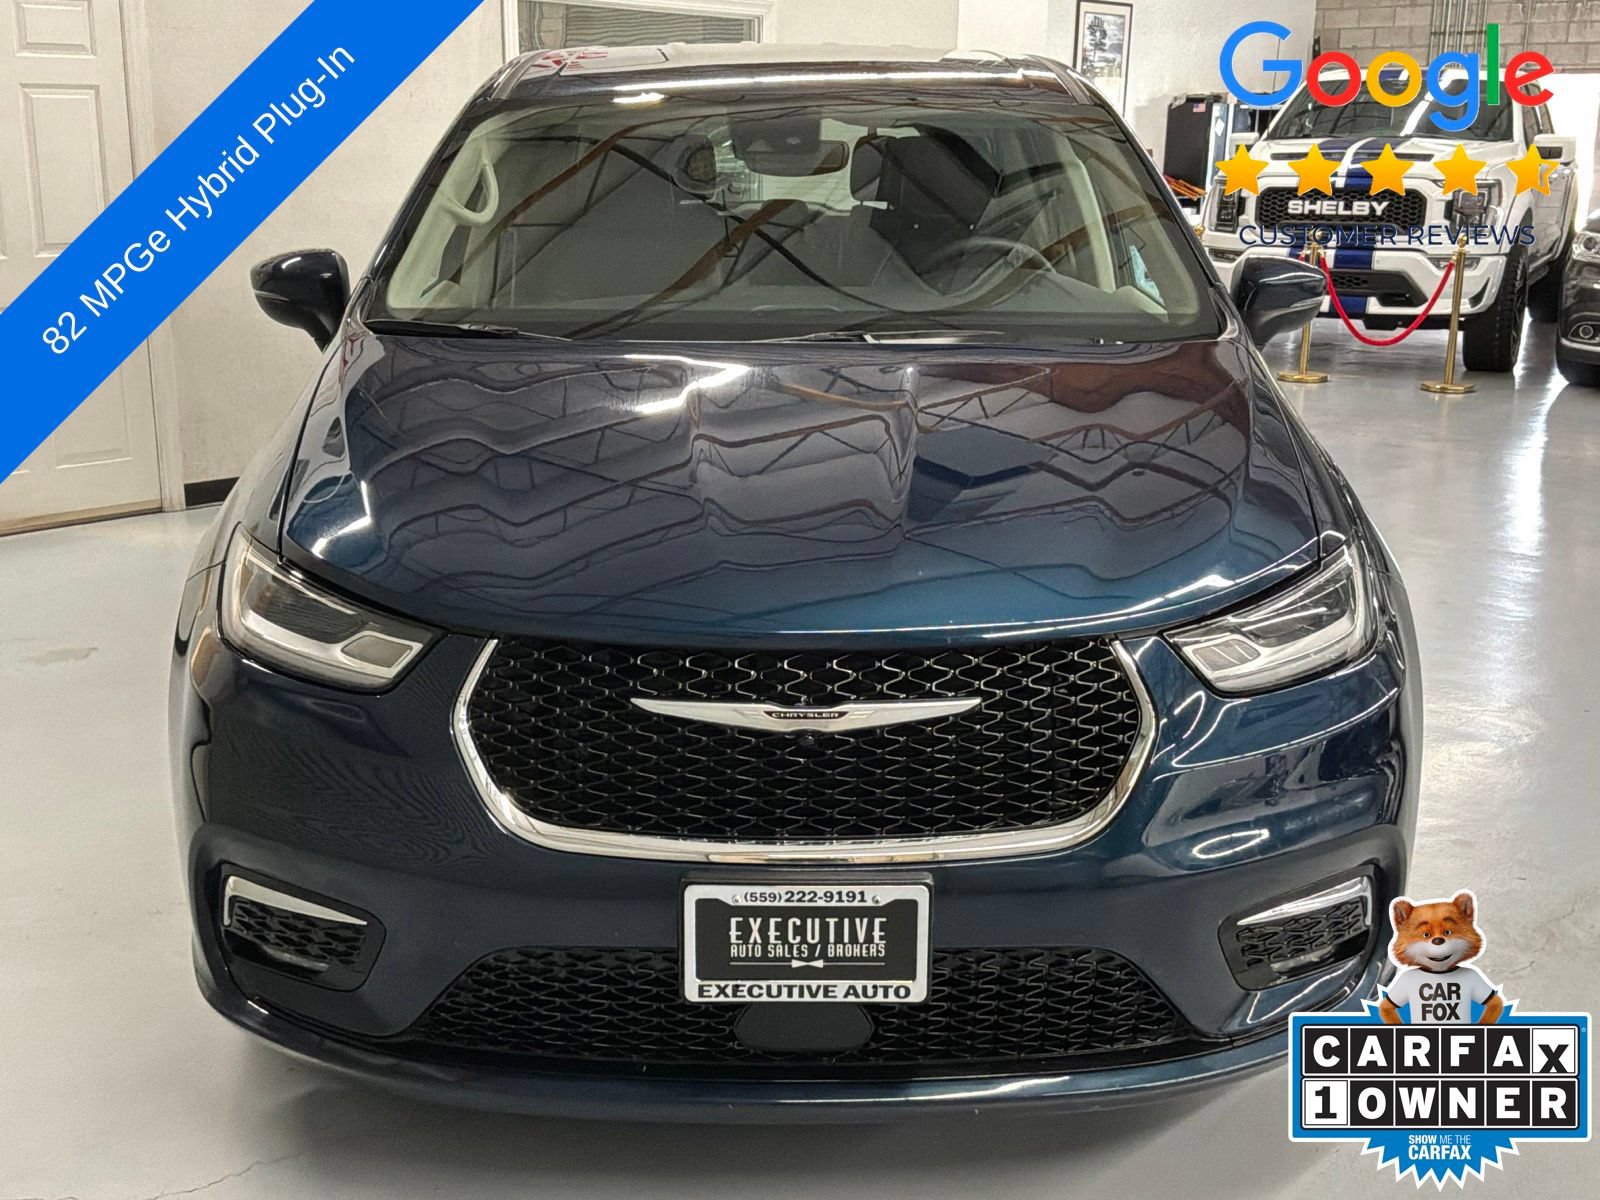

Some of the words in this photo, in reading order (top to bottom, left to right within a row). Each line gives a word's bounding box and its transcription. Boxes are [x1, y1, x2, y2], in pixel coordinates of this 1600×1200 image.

[1287, 200, 1389, 217] SHELBY
[743, 891, 782, 904] (559)
[784, 890, 867, 903] 222-9191
[729, 917, 887, 944] EXECUTIVE
[730, 944, 762, 958] AUTO
[767, 944, 809, 958] SALES
[827, 944, 886, 958] BROKERS
[697, 984, 838, 998] EXECUTIVE
[843, 984, 911, 999] AUTO
